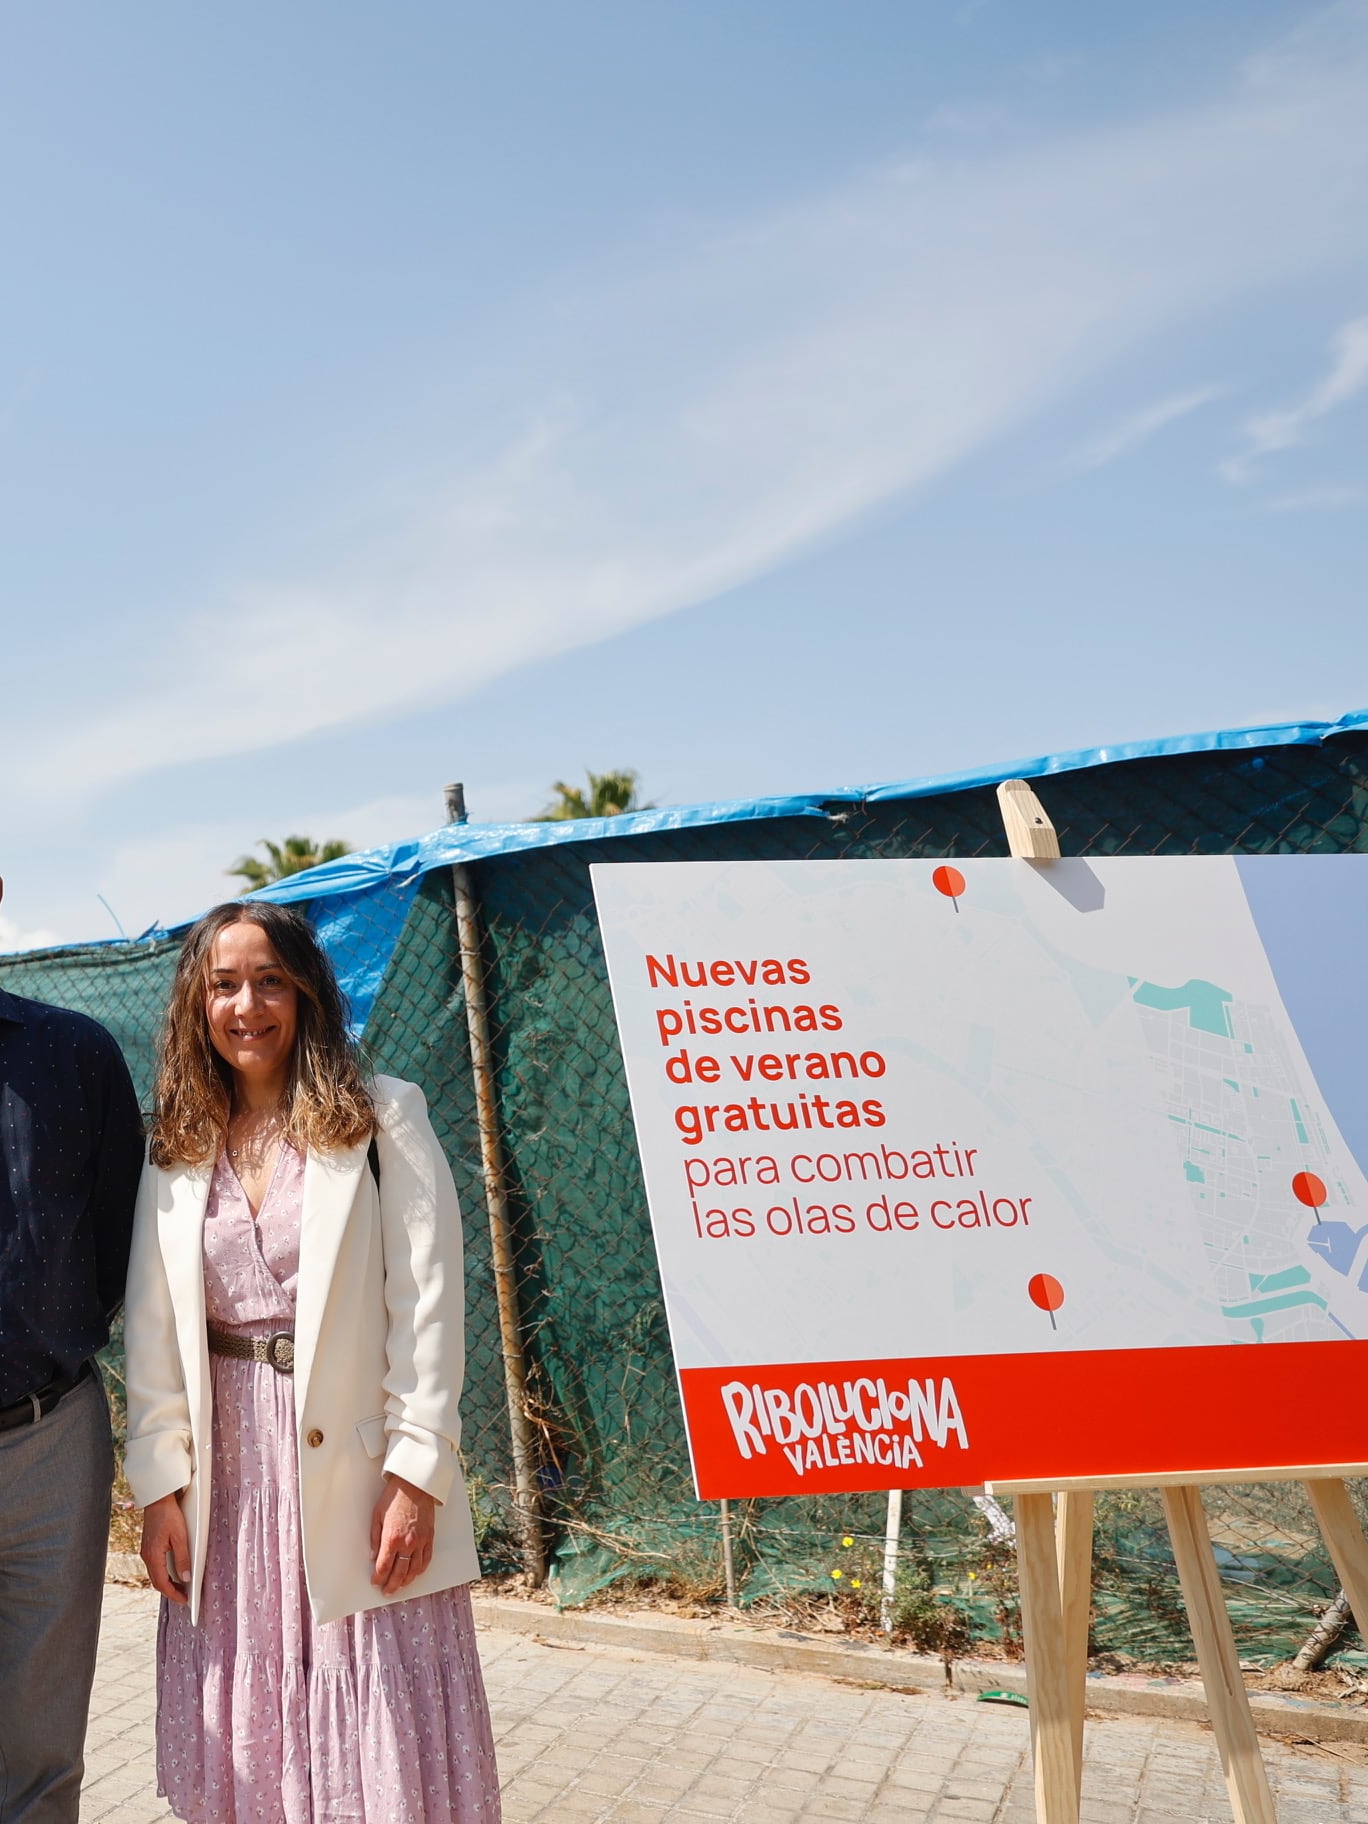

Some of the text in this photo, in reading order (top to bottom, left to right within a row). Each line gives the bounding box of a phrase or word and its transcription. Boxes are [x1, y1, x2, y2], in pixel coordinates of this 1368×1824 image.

[645, 954, 811, 988] Nuevas
[656, 998, 843, 1047] piscinas
[665, 1048, 887, 1085] de verano
[674, 1093, 887, 1146] gratuitas
[684, 1143, 978, 1198] para combatir
[692, 1190, 1032, 1239] las olas de calor
